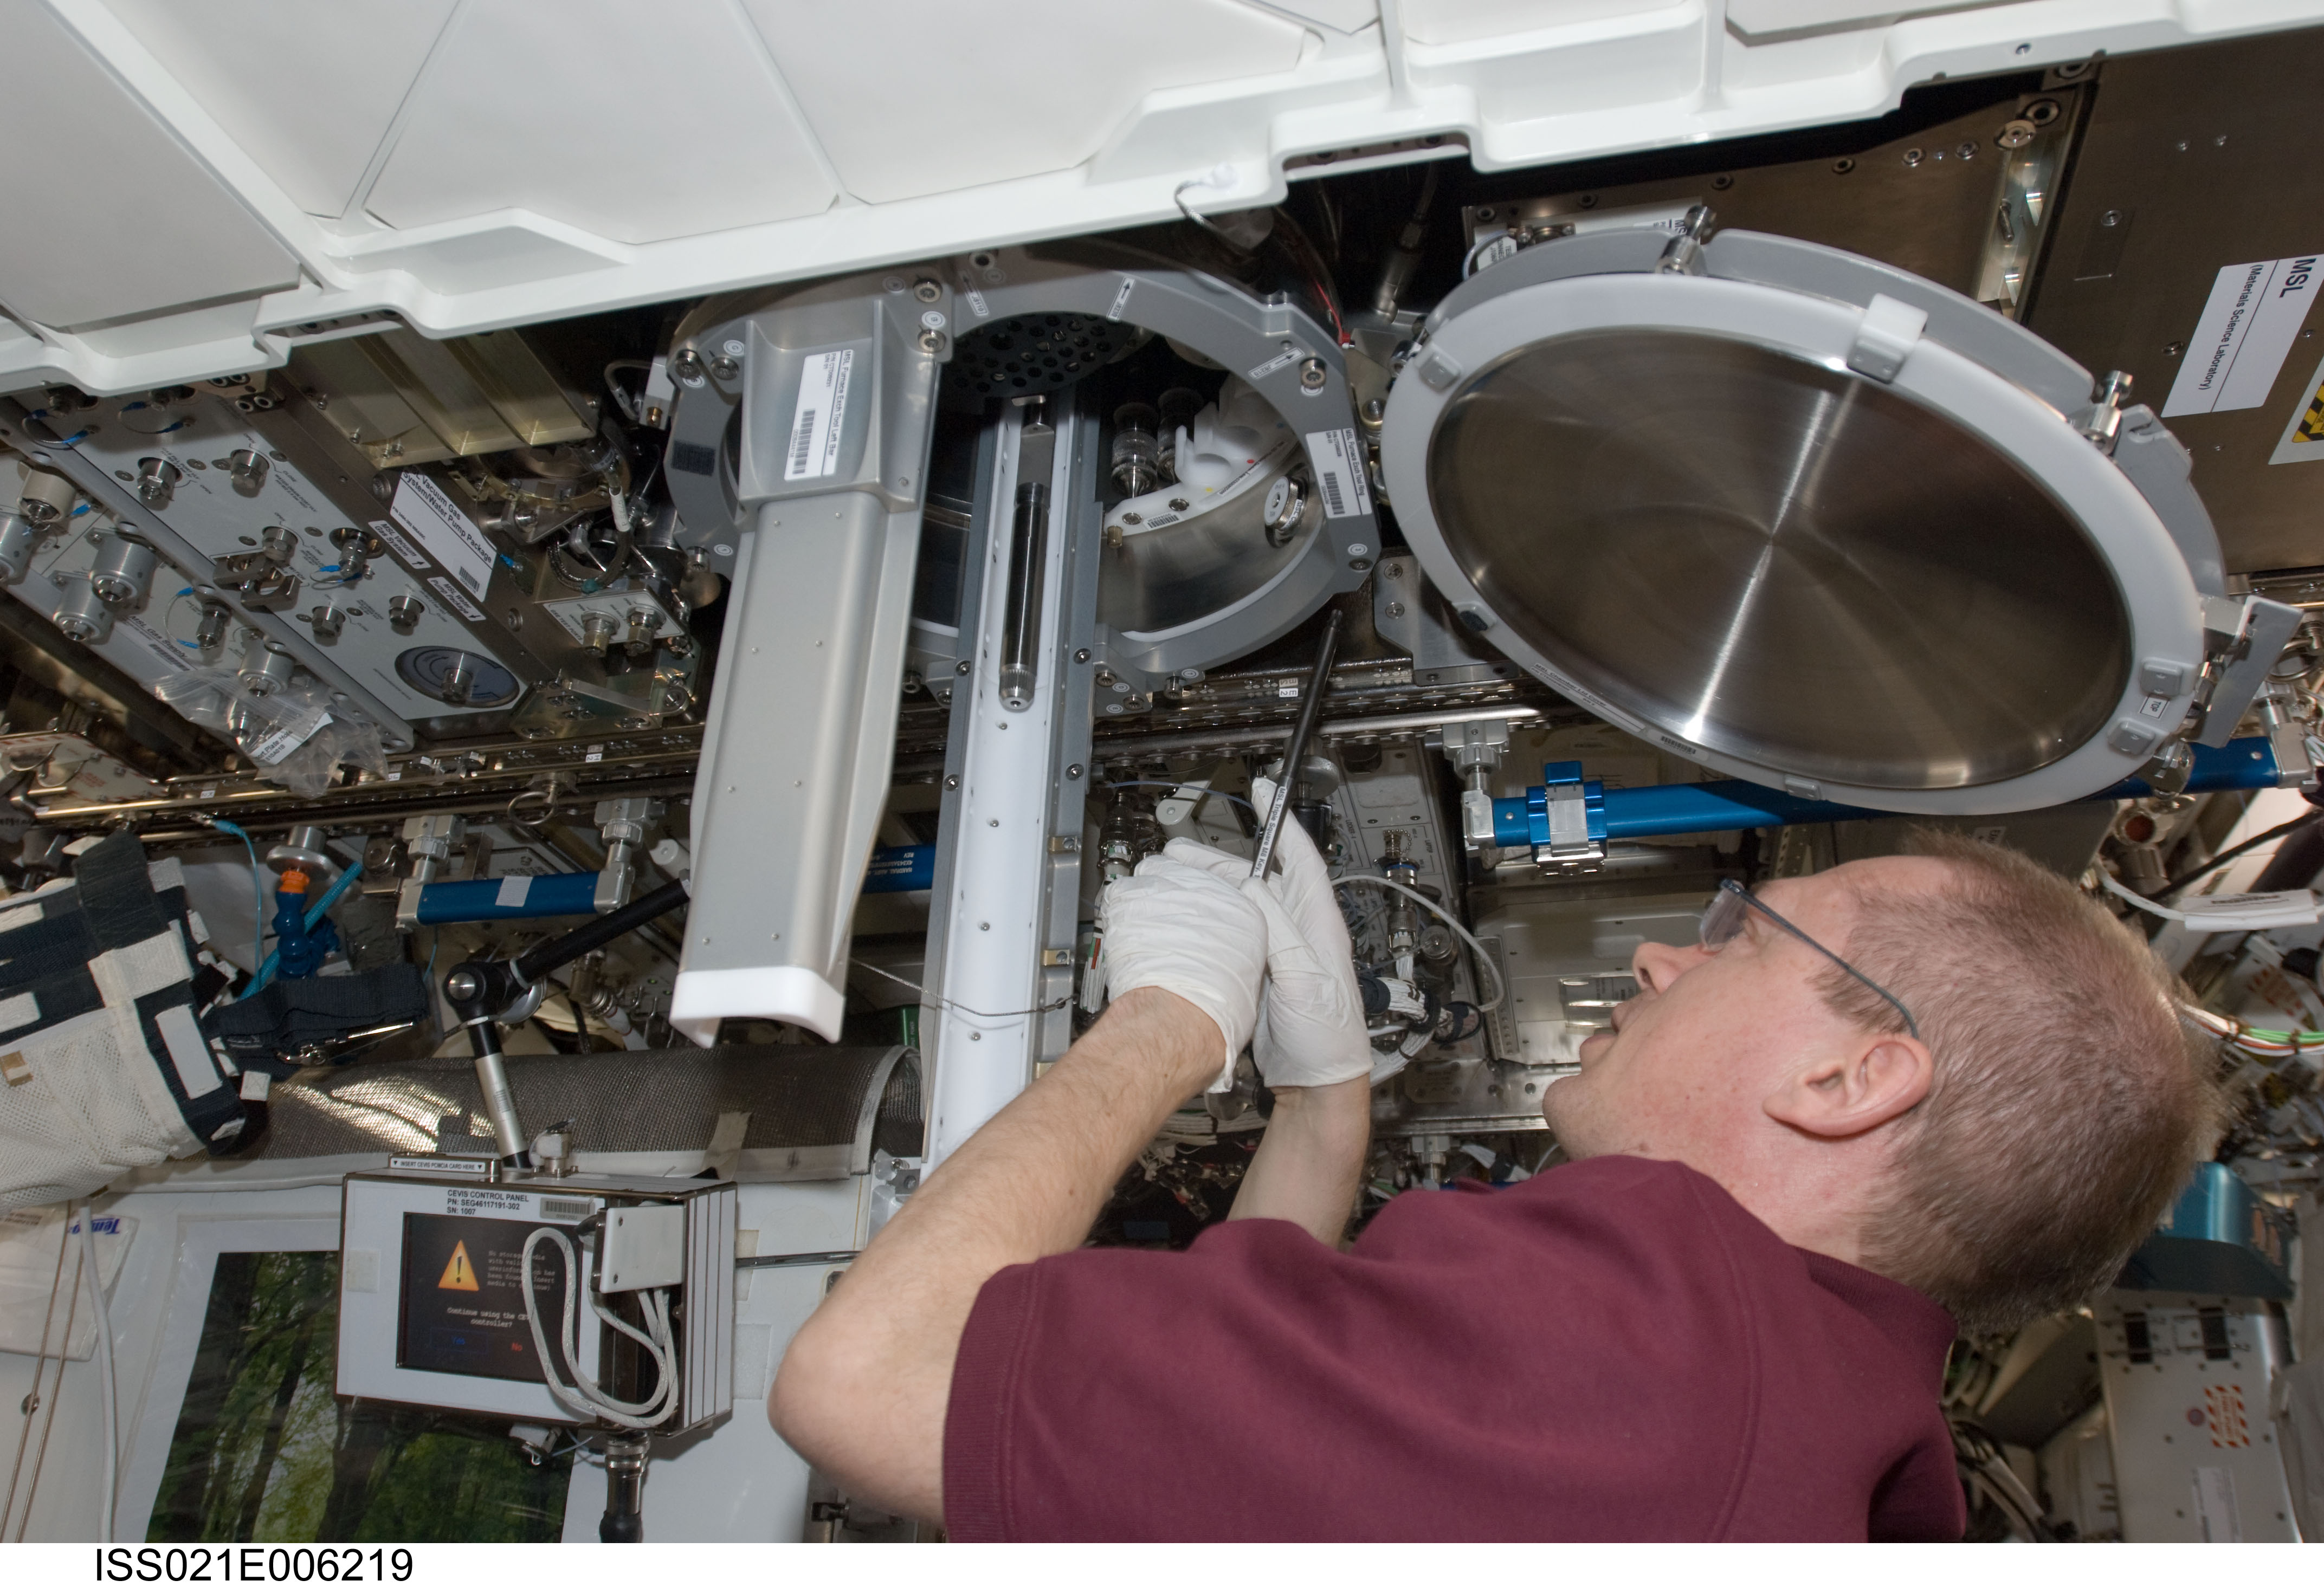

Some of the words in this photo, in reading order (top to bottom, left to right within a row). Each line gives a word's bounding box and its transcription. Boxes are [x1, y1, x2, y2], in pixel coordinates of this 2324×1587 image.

[1674, 219, 1687, 234] MS
[2236, 264, 2264, 307] (Materials
[2279, 258, 2317, 298] MSL
[2221, 309, 2244, 342] Science
[2198, 344, 2230, 390] Laboratory)
[840, 367, 849, 393] Furnace
[831, 429, 839, 443] Left
[828, 444, 836, 456] Bar
[1348, 442, 1357, 461] Furnace
[423, 475, 447, 506] Vacuum
[448, 504, 461, 520] Gas
[403, 471, 448, 517] System/Water
[448, 516, 466, 537] Pump
[467, 534, 492, 563] Package
[375, 525, 387, 539] Gas
[386, 537, 408, 557] System
[380, 523, 395, 536] MSL
[394, 535, 417, 557] Vacuum
[430, 579, 448, 595] Pump
[448, 594, 469, 614] Package
[443, 583, 456, 595] MSL
[456, 593, 472, 609] Water
[130, 616, 146, 628] MSL
[146, 628, 163, 640] Gas
[163, 639, 188, 658] Supply
[1588, 694, 1607, 707] Cover
[2149, 701, 2162, 712] TOP
[266, 740, 280, 754] Plate
[1276, 787, 1286, 802] MSL
[1270, 803, 1282, 821] Triple
[1263, 822, 1276, 846] Square
[1254, 858, 1266, 872] Key,
[447, 1189, 469, 1198] CEVIS
[470, 1190, 505, 1201] CONTROL
[505, 1193, 530, 1202] PANEL
[461, 1199, 520, 1210] SEG46117191-302
[72, 1217, 121, 1235] Temo
[447, 1307, 477, 1316] Continue
[480, 1311, 501, 1320] using
[470, 1318, 513, 1328] controller?
[453, 1336, 466, 1345] Yes
[511, 1342, 523, 1352] No
